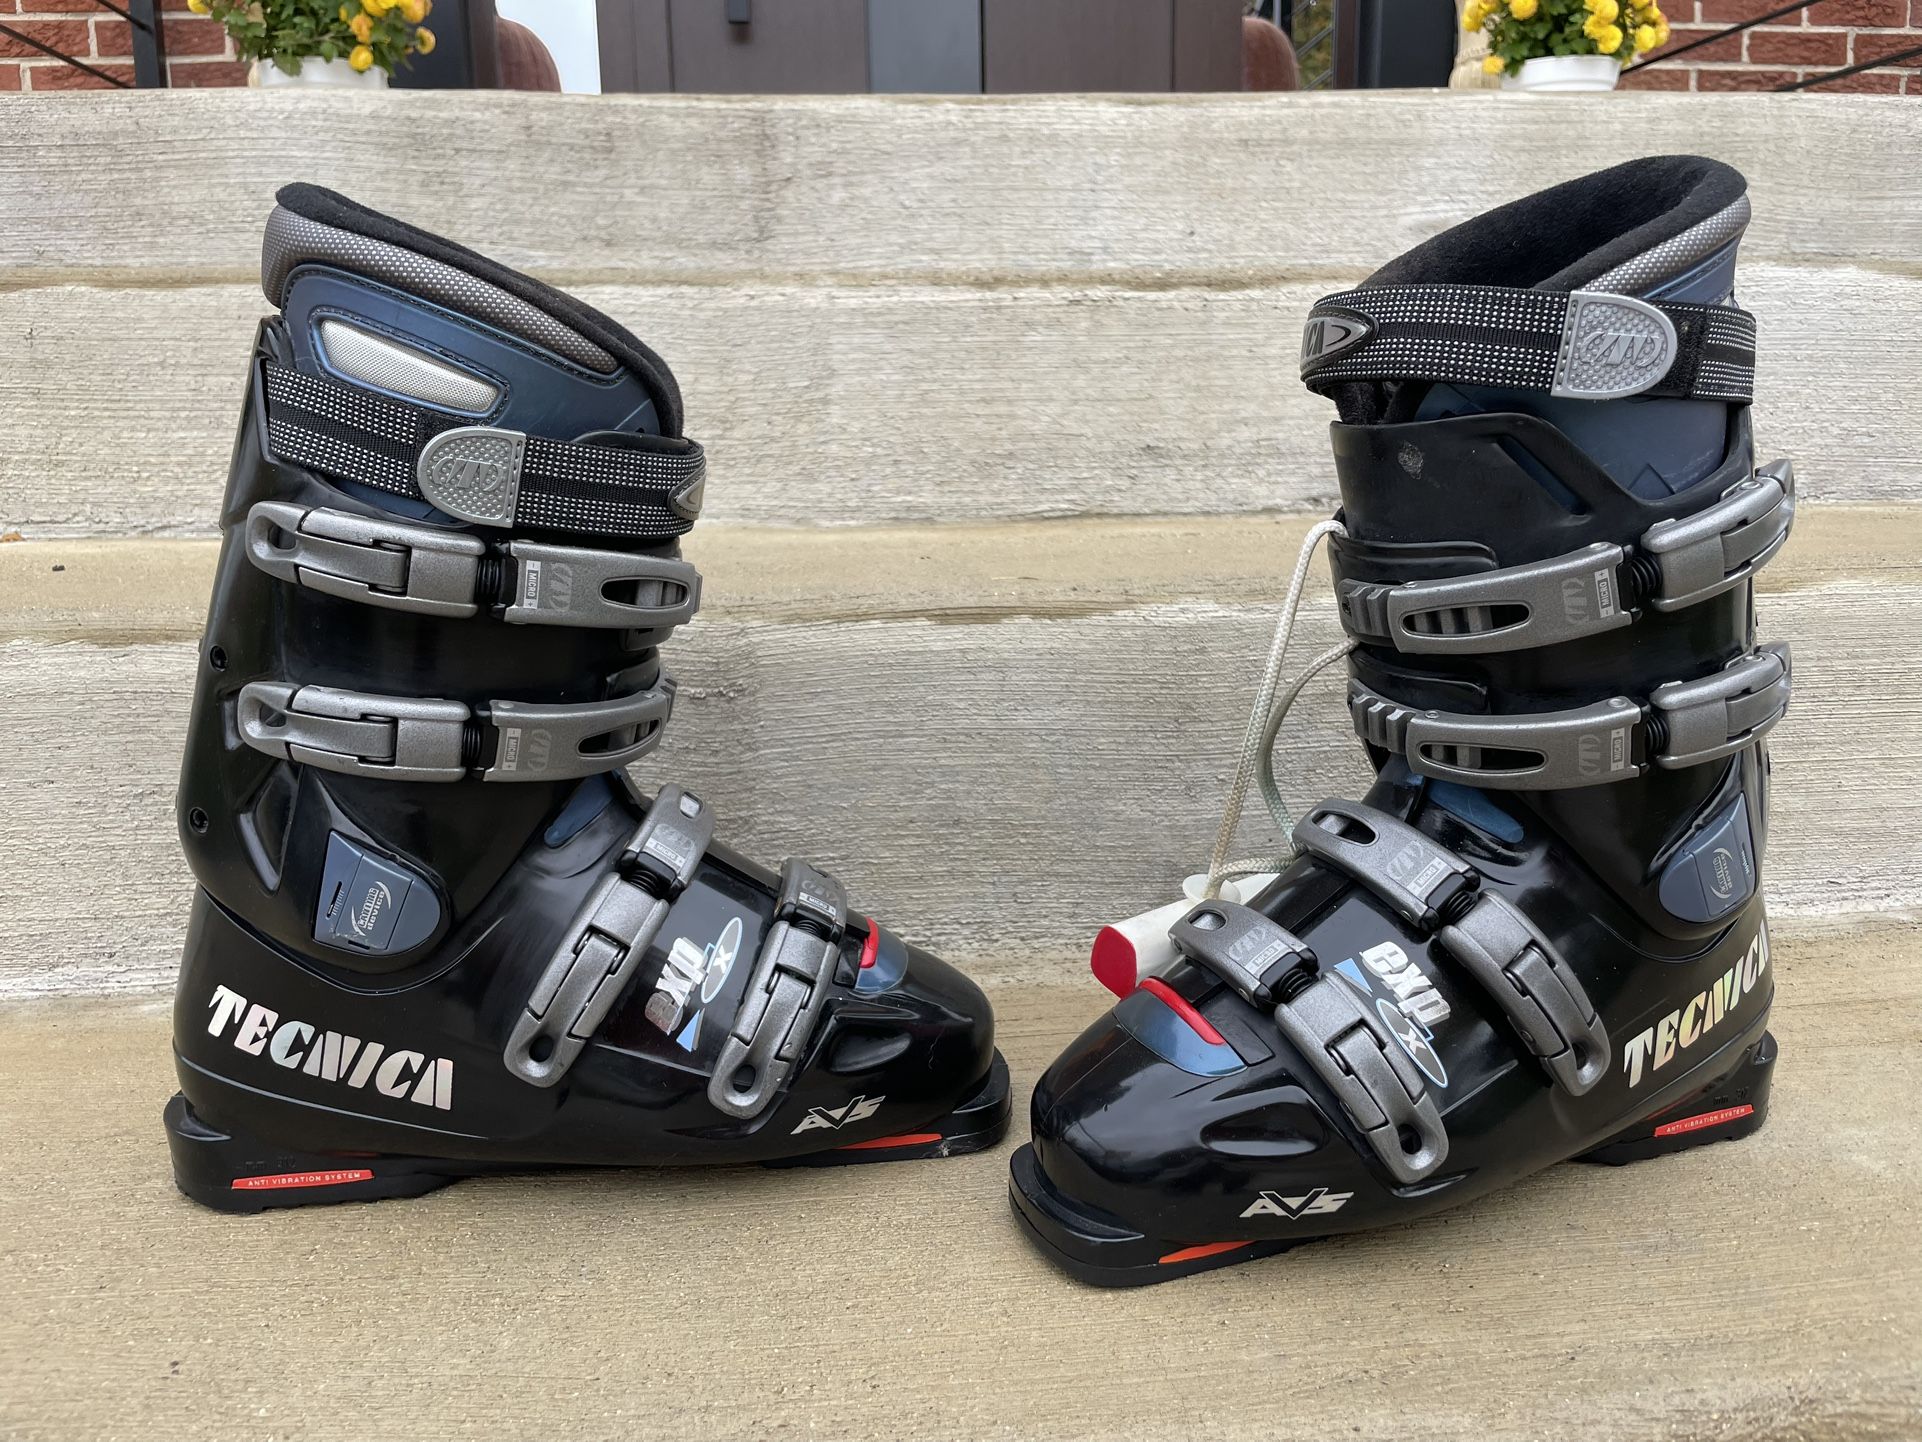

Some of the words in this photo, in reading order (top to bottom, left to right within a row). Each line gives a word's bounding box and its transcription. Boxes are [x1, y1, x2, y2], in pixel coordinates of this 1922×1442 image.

[527, 572, 538, 598] MICRO
[1599, 581, 1611, 606] MICRO
[507, 738, 518, 761] MICRO
[1613, 739, 1623, 761] MICRO
[655, 843, 677, 859] MICRO
[1415, 865, 1438, 885] MICRO
[207, 984, 454, 1111] TECNICA
[790, 1095, 886, 1135] AVS
[1666, 1124, 1682, 1133] ANTI
[1684, 1115, 1719, 1129] VIBRATION
[1720, 1107, 1746, 1120] SYSTEM
[272, 1175, 321, 1185] VIBRATION
[325, 1172, 361, 1181] SYSTEM
[1239, 1187, 1354, 1220] AVS
